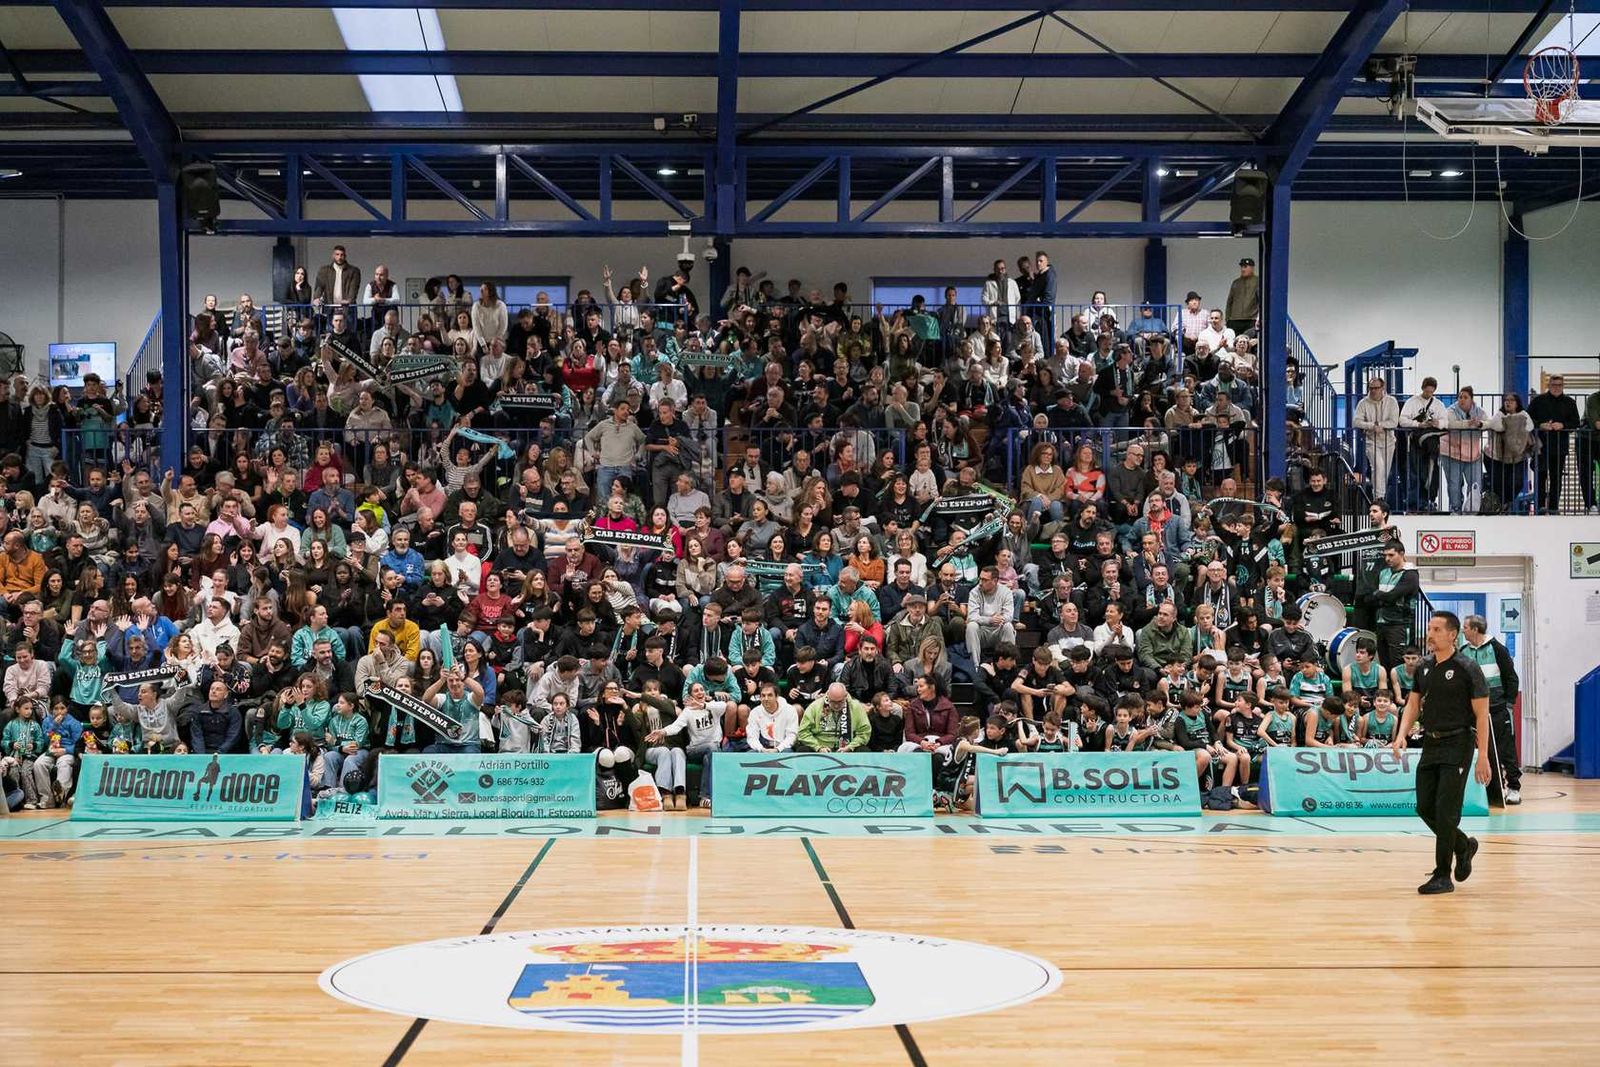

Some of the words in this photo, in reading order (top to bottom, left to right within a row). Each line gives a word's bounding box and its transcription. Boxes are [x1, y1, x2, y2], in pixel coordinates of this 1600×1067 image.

[332, 339, 347, 350] CAB
[390, 373, 405, 381] CAB
[406, 364, 445, 378] ESTEPONA
[512, 396, 552, 404] ESTEPONA
[595, 529, 614, 539] CAB
[615, 531, 662, 543] ESTEPONA
[1316, 541, 1333, 551] CAB
[1334, 534, 1376, 548] ESTEPONA
[1241, 547, 1250, 555] 14
[1312, 561, 1318, 569] 9
[1365, 562, 1375, 571] 77
[107, 671, 128, 683] CAB
[382, 686, 401, 701] CAB
[402, 697, 449, 730] ESTEPONA
[406, 761, 428, 778] CASA
[430, 759, 455, 778] PORTI
[479, 760, 512, 770] Adrián
[514, 759, 550, 770] Portillo
[1294, 750, 1422, 781] super
[94, 761, 195, 800] jugador
[219, 772, 280, 804] doce
[496, 778, 514, 786] 686
[514, 778, 530, 786] 754
[531, 778, 545, 786] 932
[743, 773, 907, 797] PLAYCAR
[477, 792, 574, 803] barcasaporti@gmail.com
[1053, 793, 1182, 804] CONSTRUCTORA
[334, 801, 362, 815] FELIZ
[826, 797, 906, 814] COSTA
[1320, 801, 1332, 809] 952
[473, 808, 499, 818] Local
[501, 808, 535, 818] Bloque
[548, 808, 593, 818] Estepona
[80, 823, 661, 838] PABELLÓN
[863, 822, 1285, 835] PINEDA
